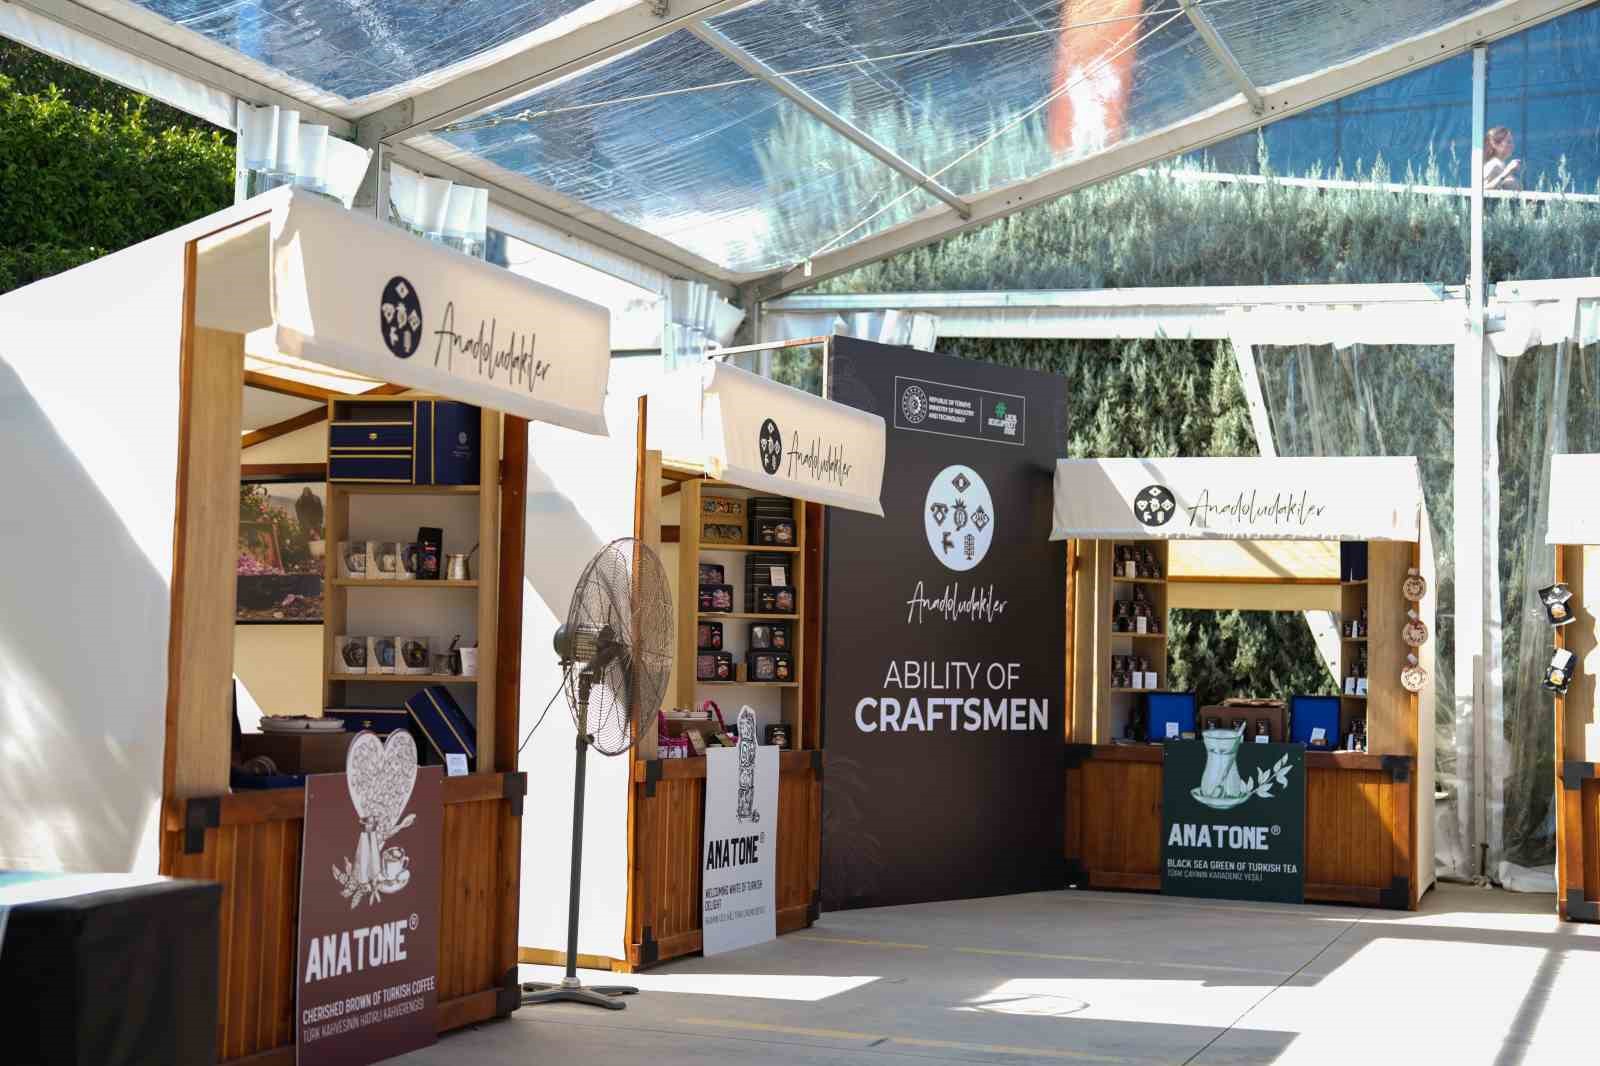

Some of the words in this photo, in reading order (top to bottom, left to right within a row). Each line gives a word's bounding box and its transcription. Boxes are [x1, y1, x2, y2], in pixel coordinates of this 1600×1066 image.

[906, 580, 1009, 625] Anadoludakiler
[883, 660, 981, 690] ABILITY
[986, 662, 1021, 690] OF
[854, 697, 1049, 733] CRAFTSMEN
[1167, 858, 1192, 869] BLACK
[1193, 859, 1209, 870] SEA
[1210, 860, 1235, 871] GREEN
[1236, 861, 1246, 872] OF
[1248, 862, 1281, 873] TURKISH
[1282, 863, 1298, 874] TEA
[303, 1001, 344, 1025] CHERISHED
[345, 994, 372, 1014] BROWN
[373, 989, 382, 1006] OF
[383, 982, 411, 1001] TURKISH
[411, 976, 435, 994] COFFEE
